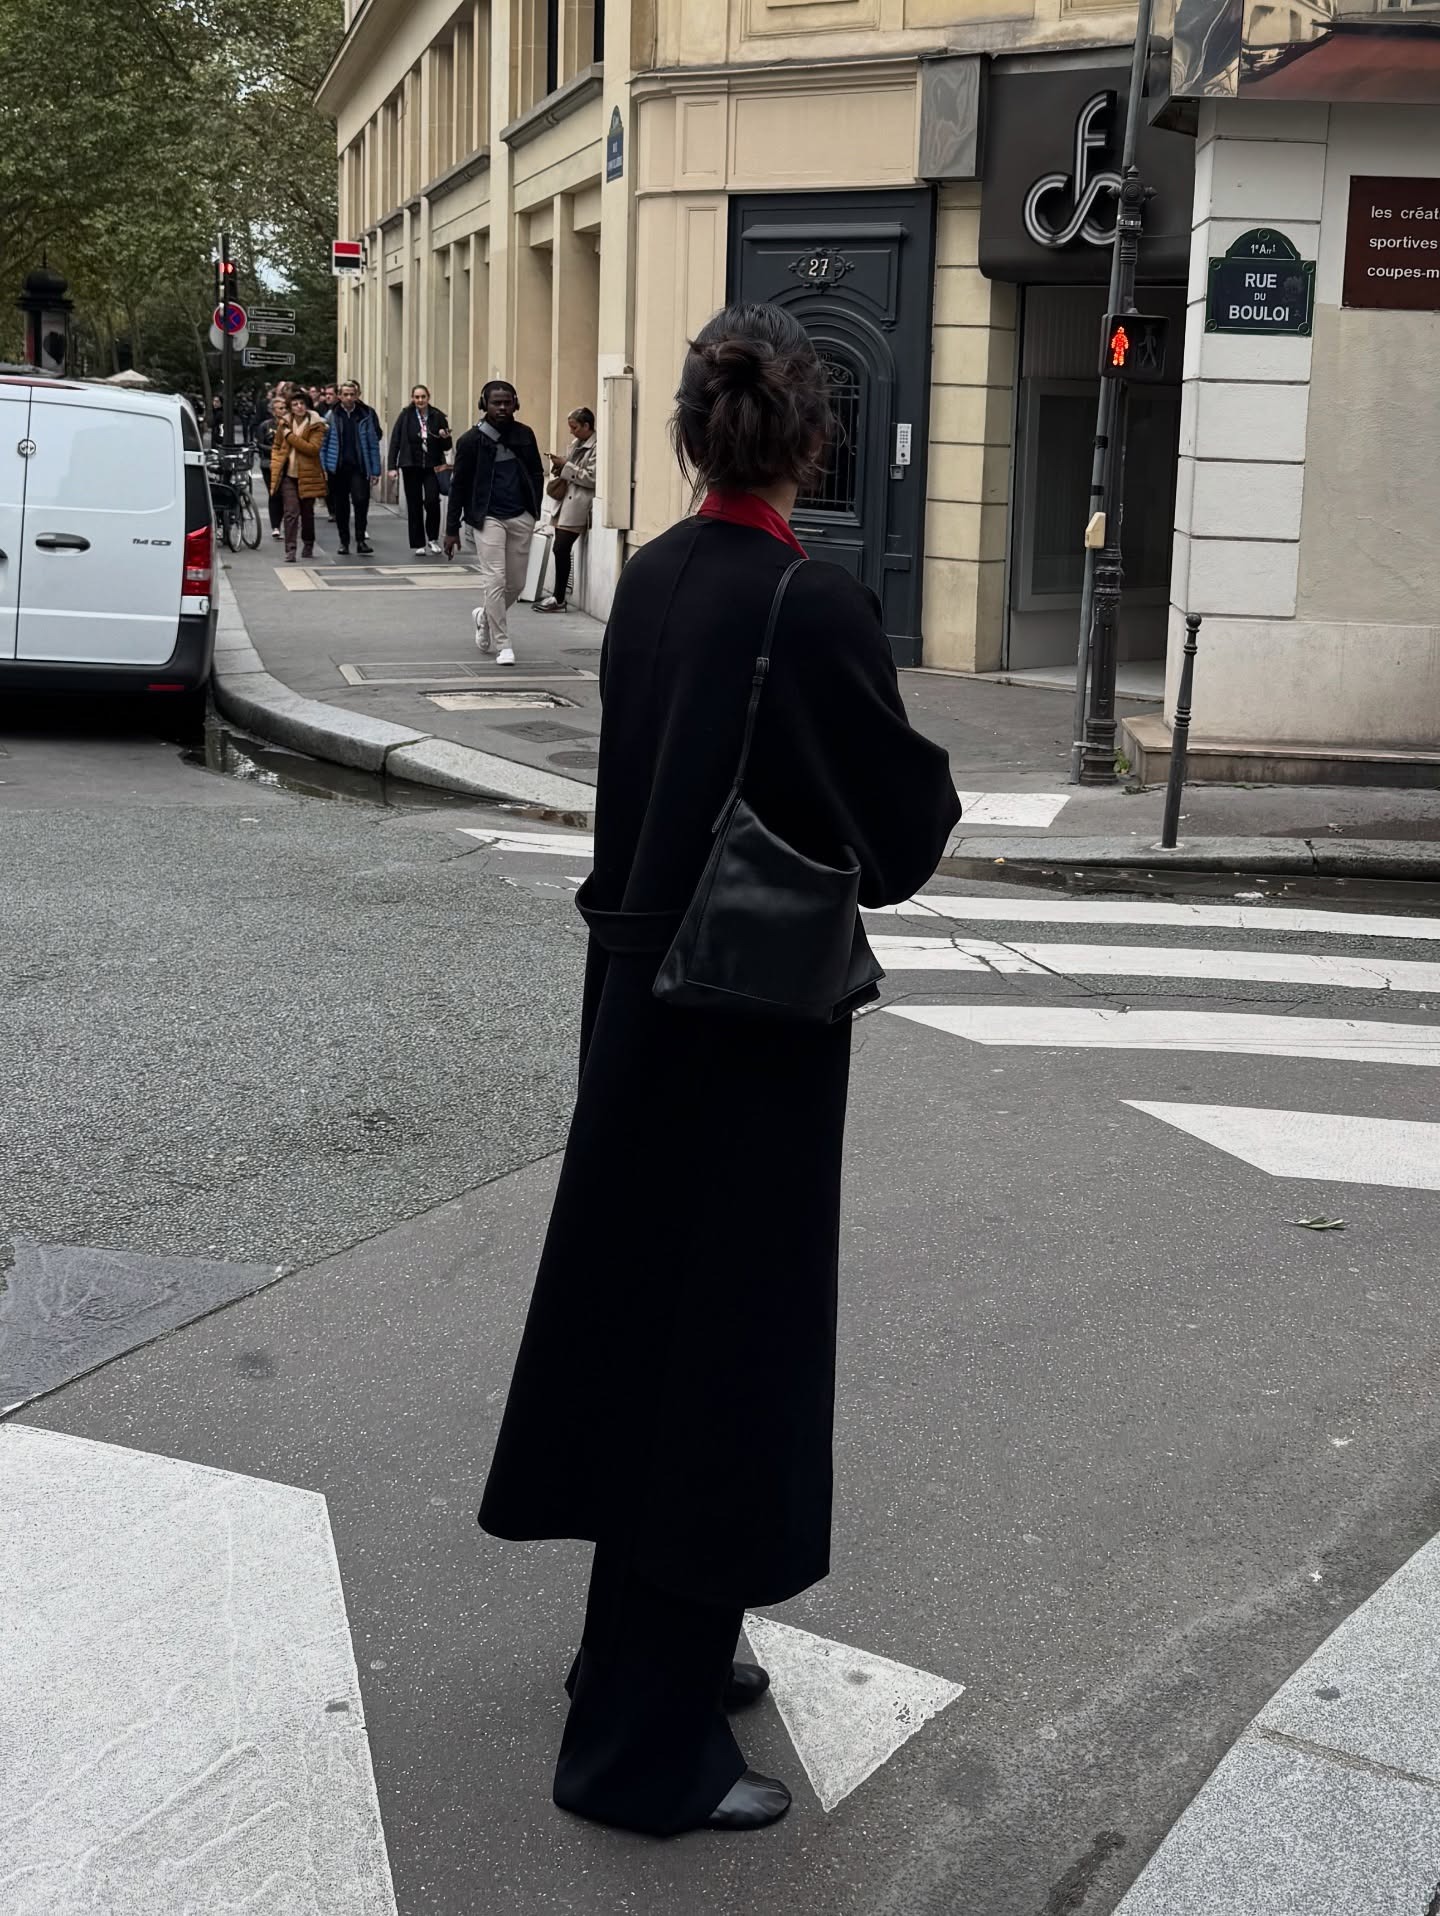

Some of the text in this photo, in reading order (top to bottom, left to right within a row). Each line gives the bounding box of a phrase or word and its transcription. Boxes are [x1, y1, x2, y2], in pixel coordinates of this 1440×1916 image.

[1371, 205, 1393, 219] les
[1369, 235, 1438, 251] sportives
[808, 258, 829, 277] 27
[1367, 266, 1440, 280] coupes-m
[1244, 272, 1278, 289] RUE
[1254, 292, 1267, 301] DU
[1228, 304, 1290, 322] BOULOI
